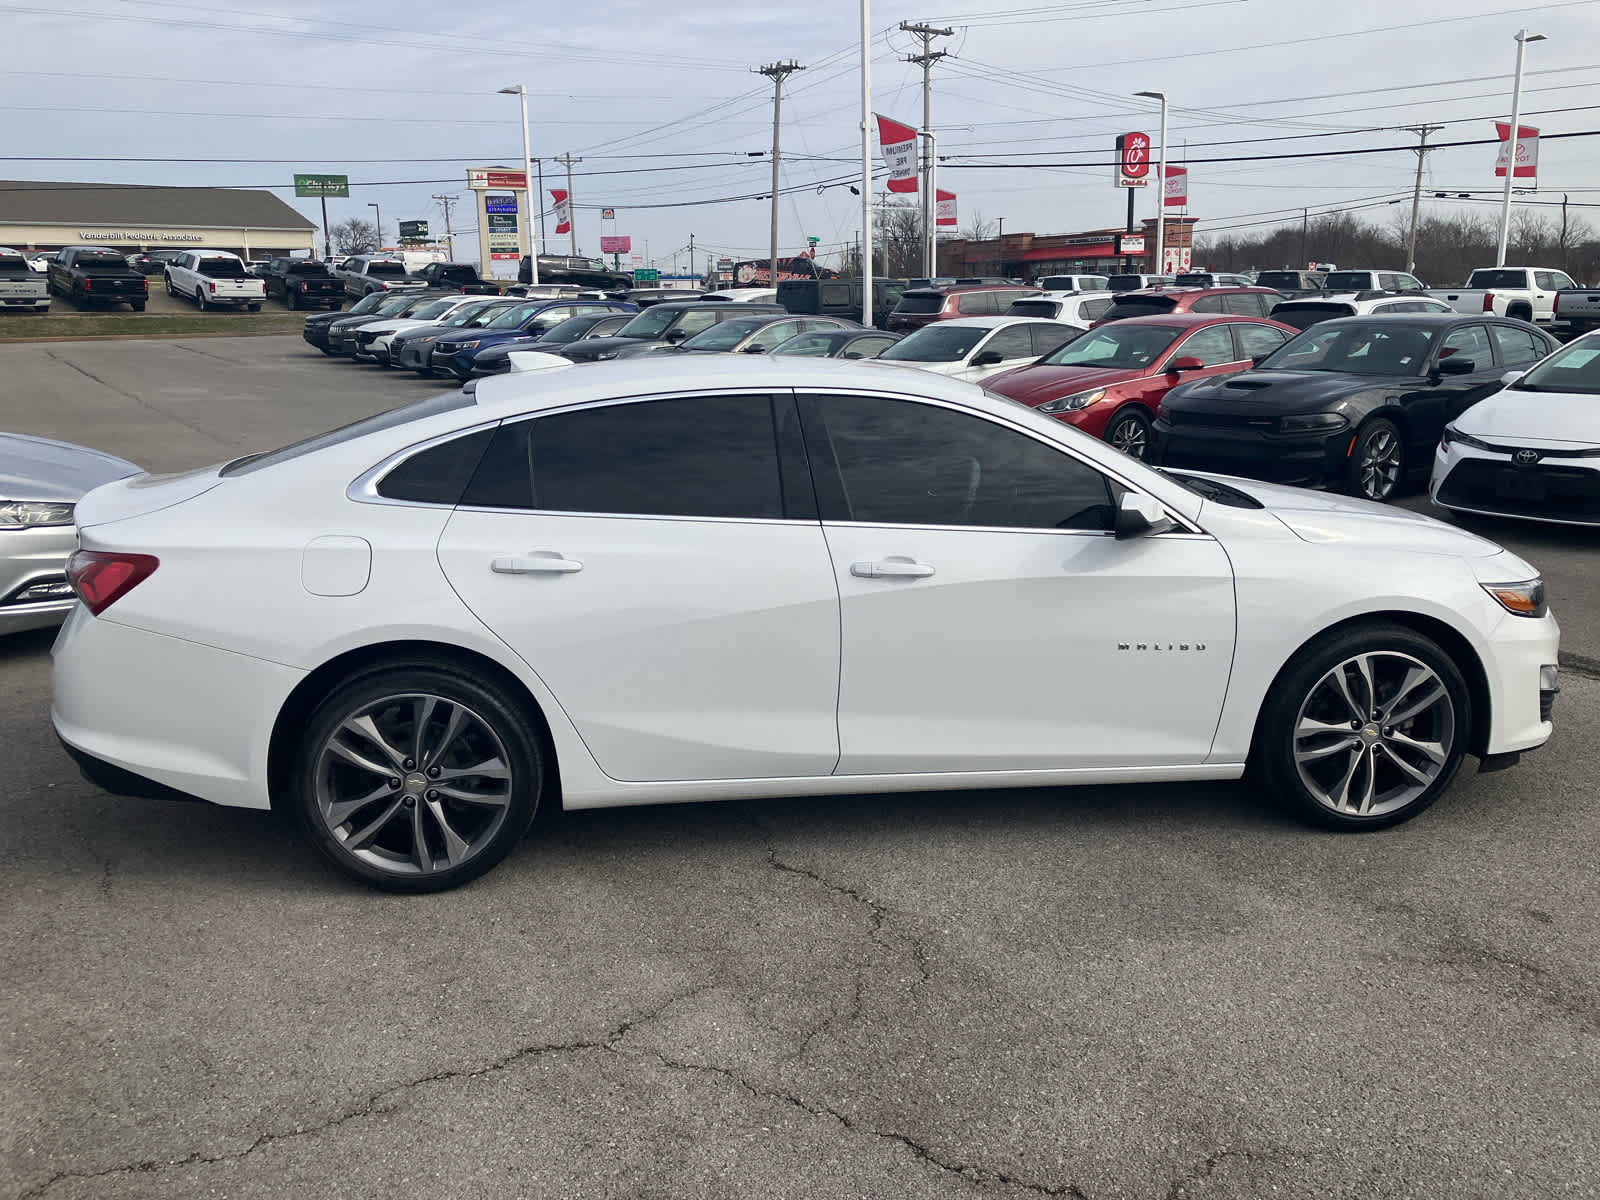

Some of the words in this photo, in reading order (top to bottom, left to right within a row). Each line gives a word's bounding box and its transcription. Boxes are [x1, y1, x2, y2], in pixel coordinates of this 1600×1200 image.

[306, 179, 346, 191] Chaleys
[79, 231, 122, 241] Vanderbilt
[1117, 642, 1207, 651] MALIBU
